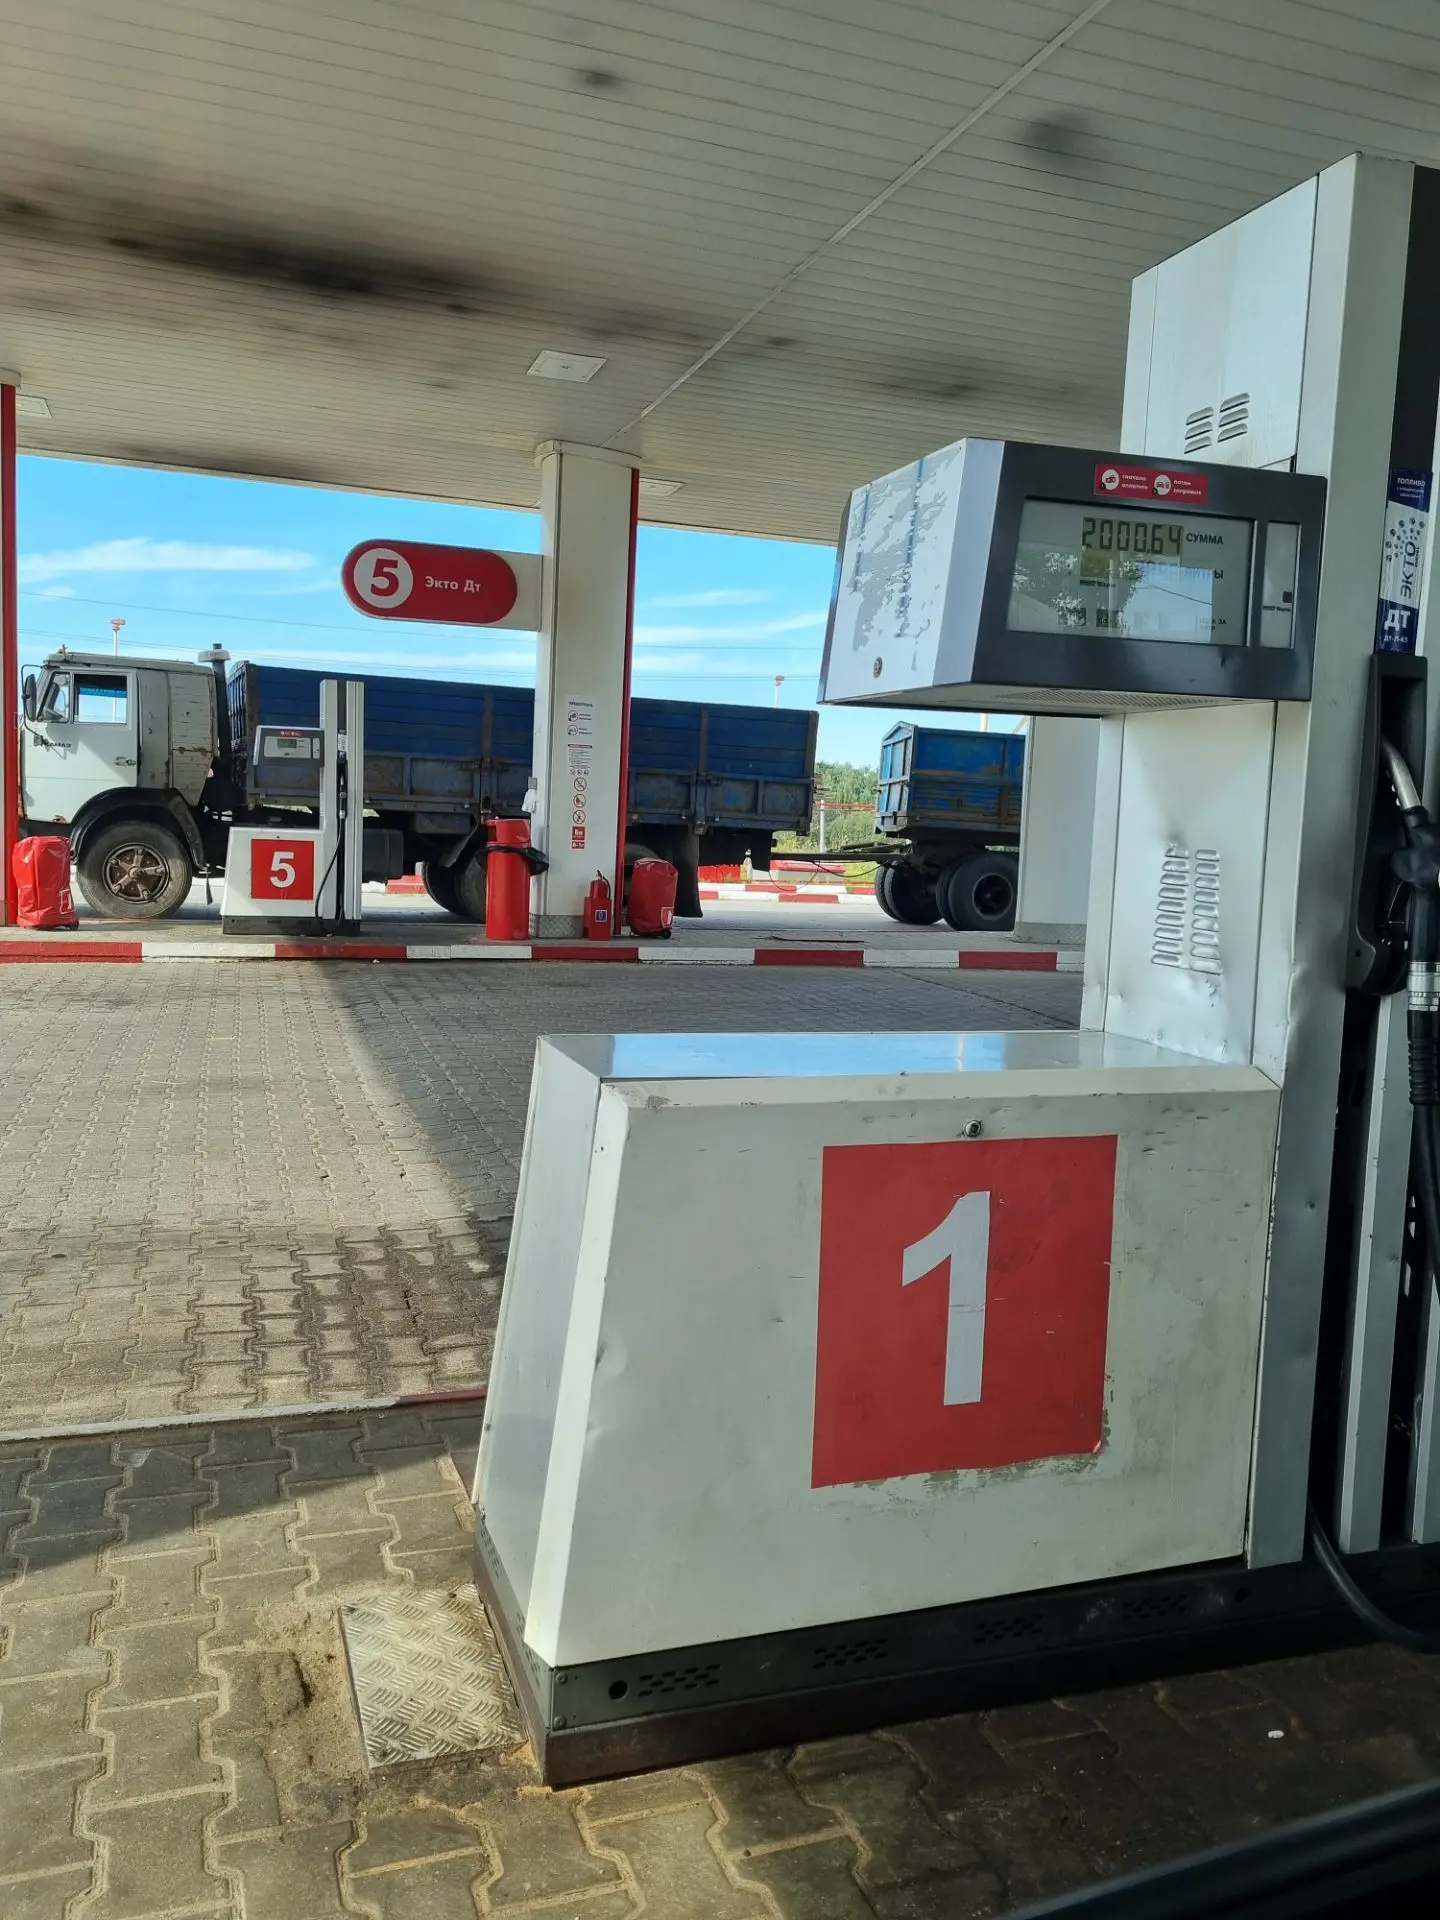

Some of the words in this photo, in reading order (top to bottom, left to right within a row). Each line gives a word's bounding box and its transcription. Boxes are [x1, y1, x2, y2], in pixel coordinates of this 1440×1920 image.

[1396, 477, 1426, 487] ТОПЛИВО
[1185, 532, 1224, 545] СУММА
[370, 558, 399, 597] 5
[424, 576, 459, 590] Экто
[463, 579, 481, 593] Дт
[1400, 541, 1416, 599] ЭКТО
[1384, 609, 1411, 631] ДТ
[269, 851, 296, 888] 5
[902, 1190, 991, 1406] 1
